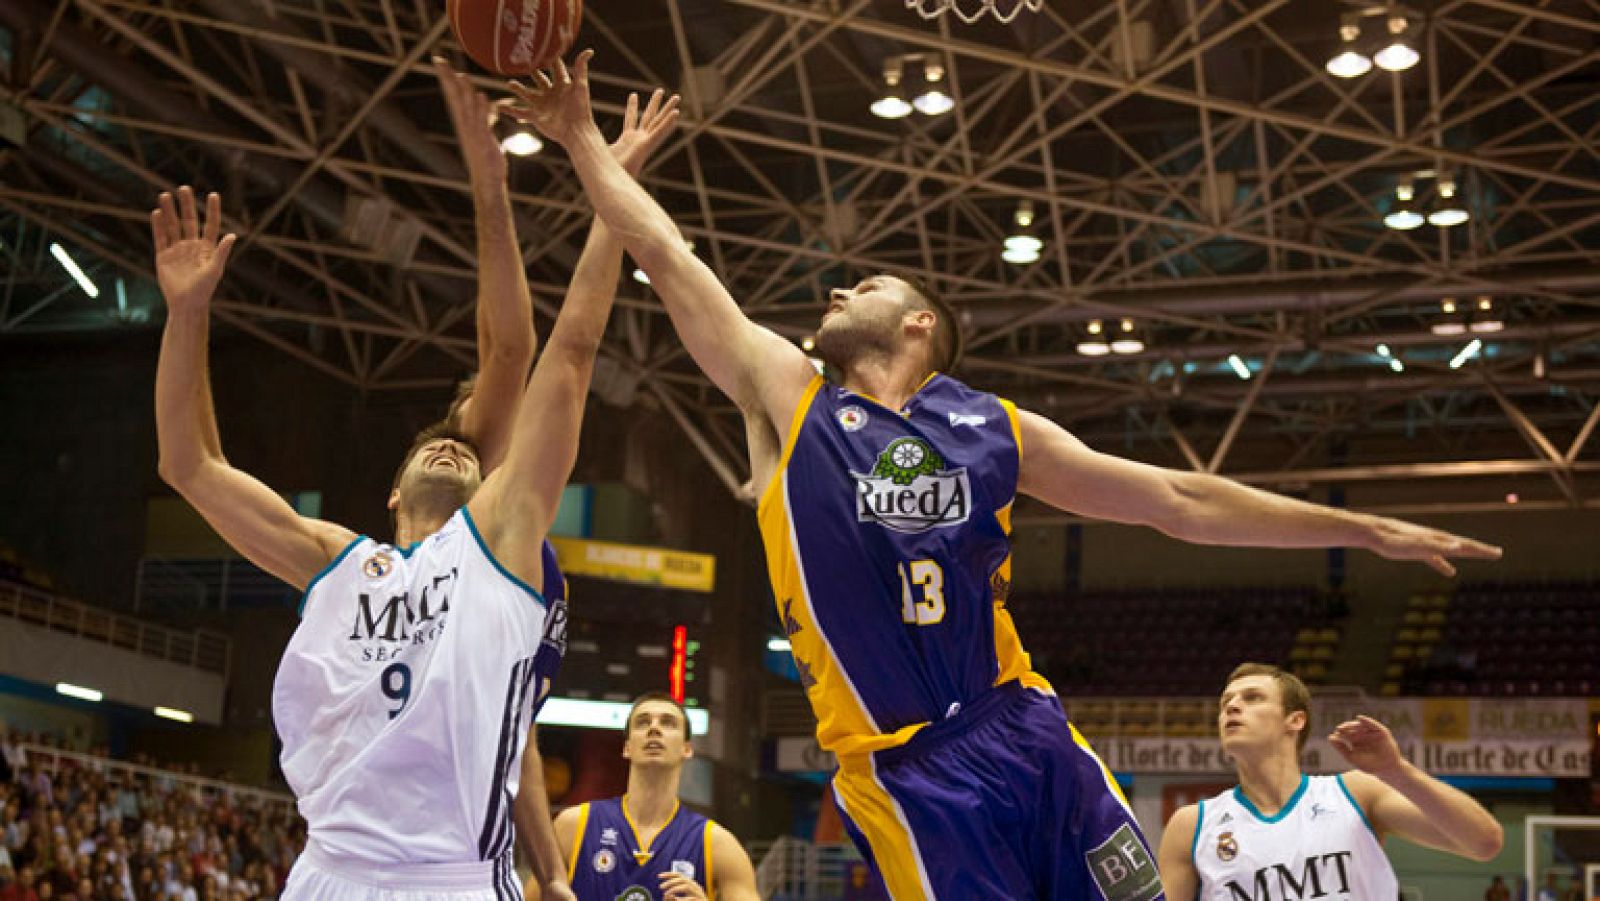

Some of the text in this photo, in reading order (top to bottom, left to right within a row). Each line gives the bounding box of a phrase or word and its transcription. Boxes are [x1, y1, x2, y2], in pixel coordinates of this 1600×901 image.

[898, 559, 946, 626] 13
[381, 662, 412, 720] 9
[1224, 851, 1352, 901] MMT
